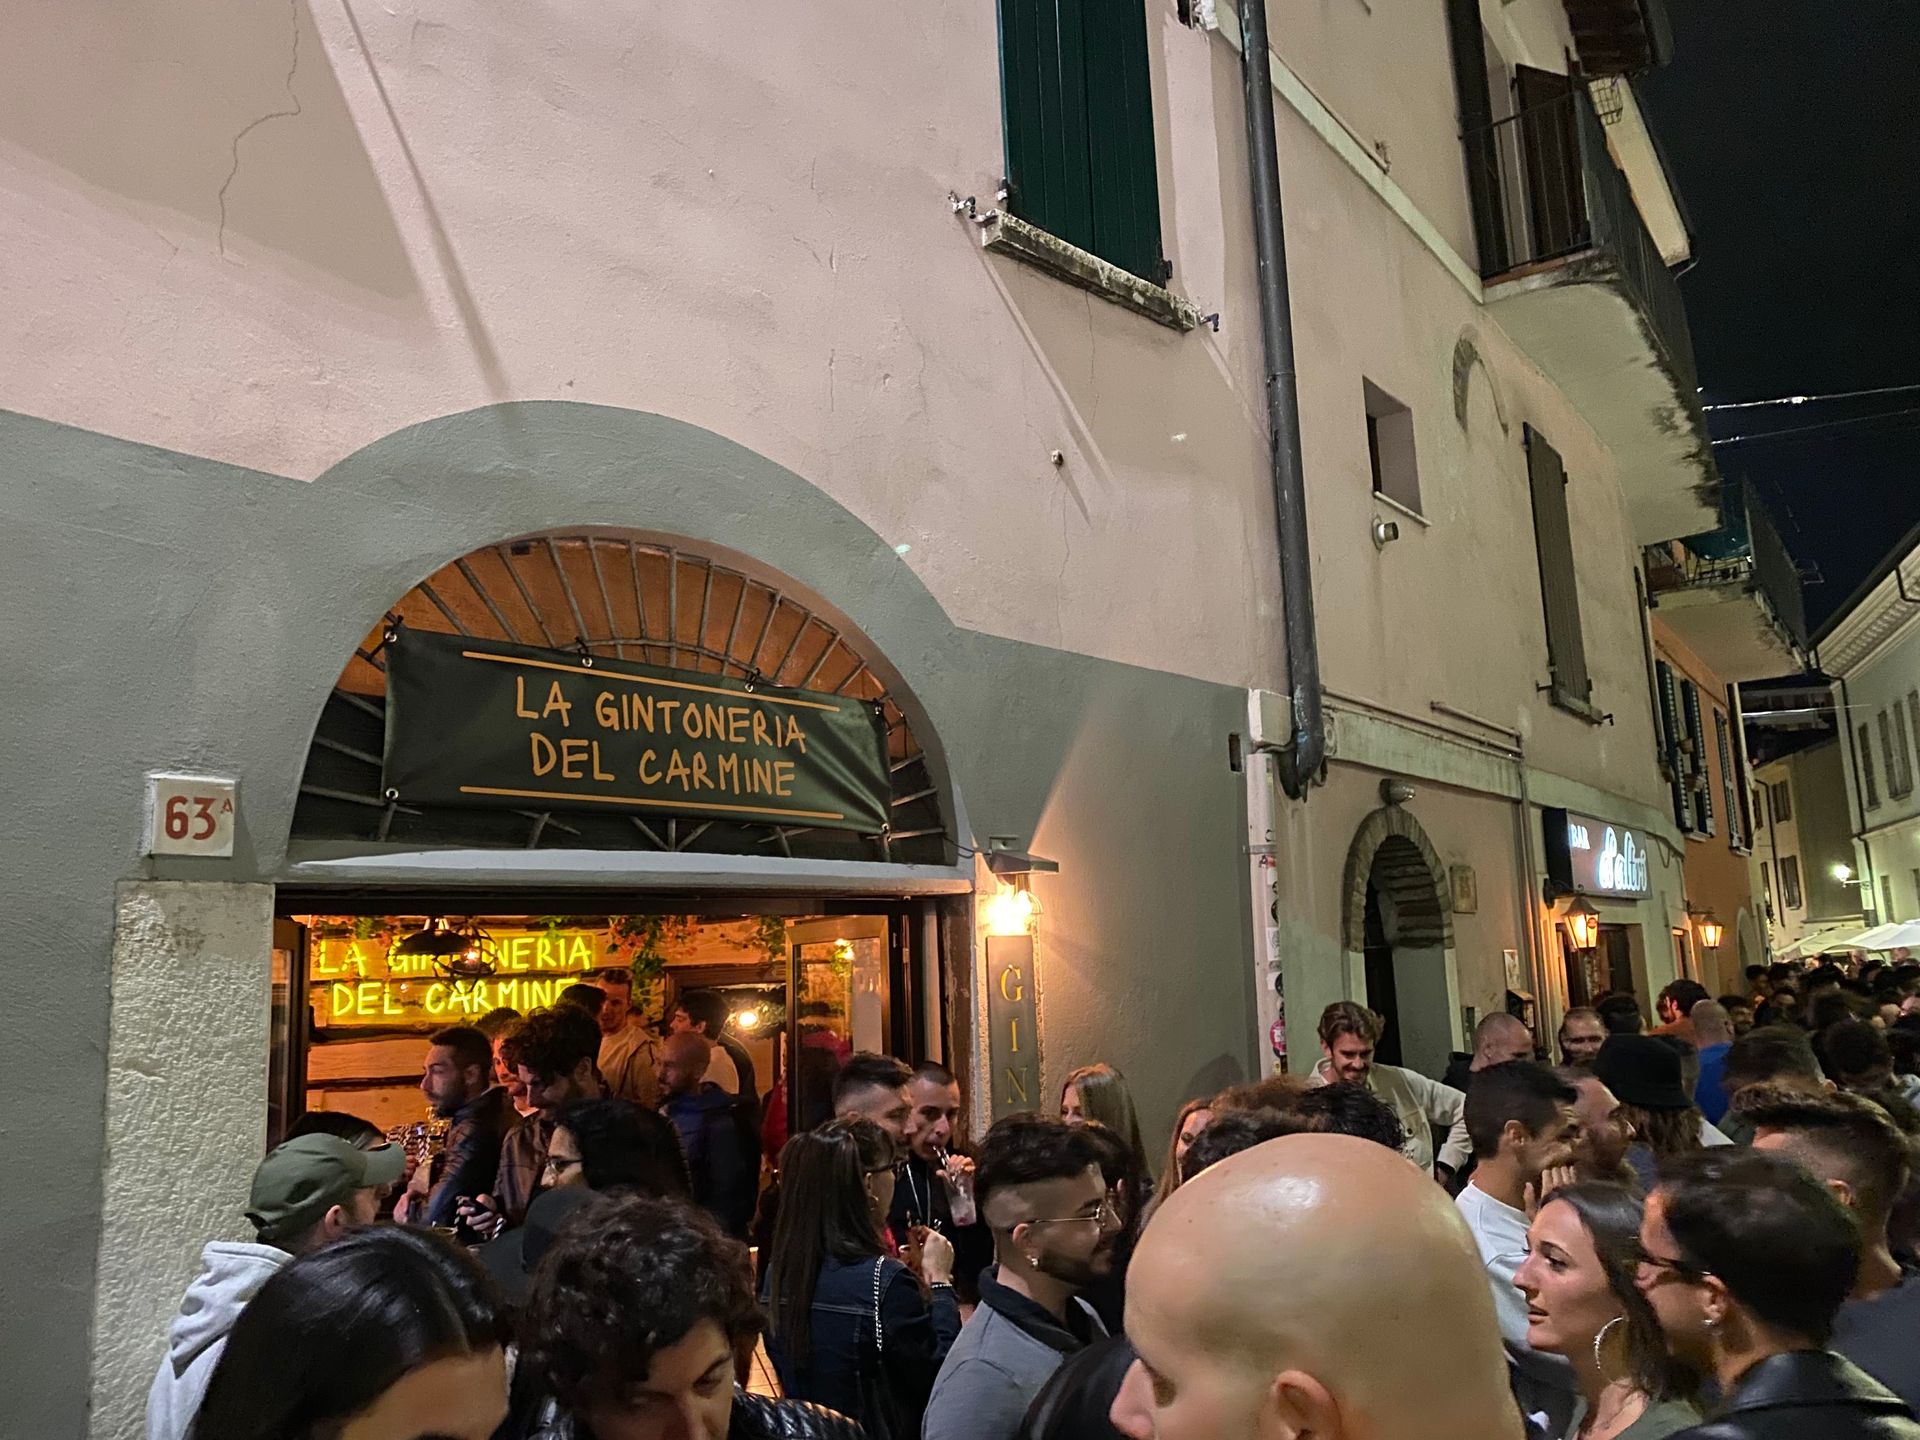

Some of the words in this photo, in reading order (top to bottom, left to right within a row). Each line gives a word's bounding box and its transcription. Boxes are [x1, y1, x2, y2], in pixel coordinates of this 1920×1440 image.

[515, 675, 572, 727] LA
[594, 690, 808, 753] GINTONERIA
[530, 732, 616, 782] DEL
[637, 748, 796, 796] CARMINE
[1569, 823, 1591, 850] BAR
[320, 938, 366, 976] LA
[331, 979, 404, 1017] DEL
[1000, 965, 1028, 1104] GIN
